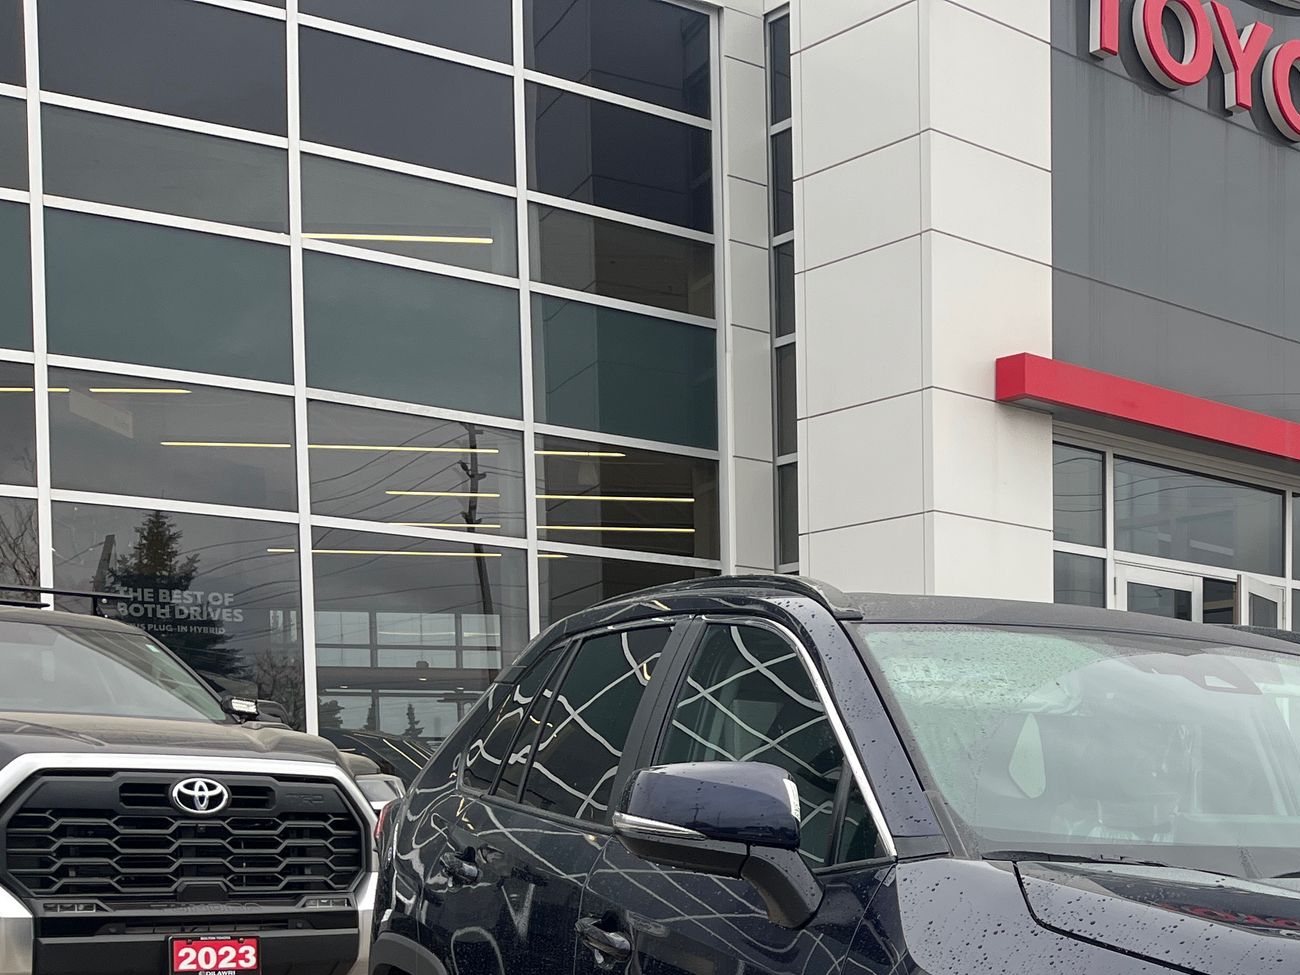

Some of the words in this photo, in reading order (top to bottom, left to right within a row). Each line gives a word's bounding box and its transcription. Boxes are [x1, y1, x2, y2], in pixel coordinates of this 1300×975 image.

[159, 588, 205, 605] BEST
[208, 591, 234, 606] OF
[117, 602, 170, 618] BOTH
[174, 604, 244, 622] DRIVES
[189, 625, 226, 635] HYBRID
[178, 945, 257, 970] 2023
